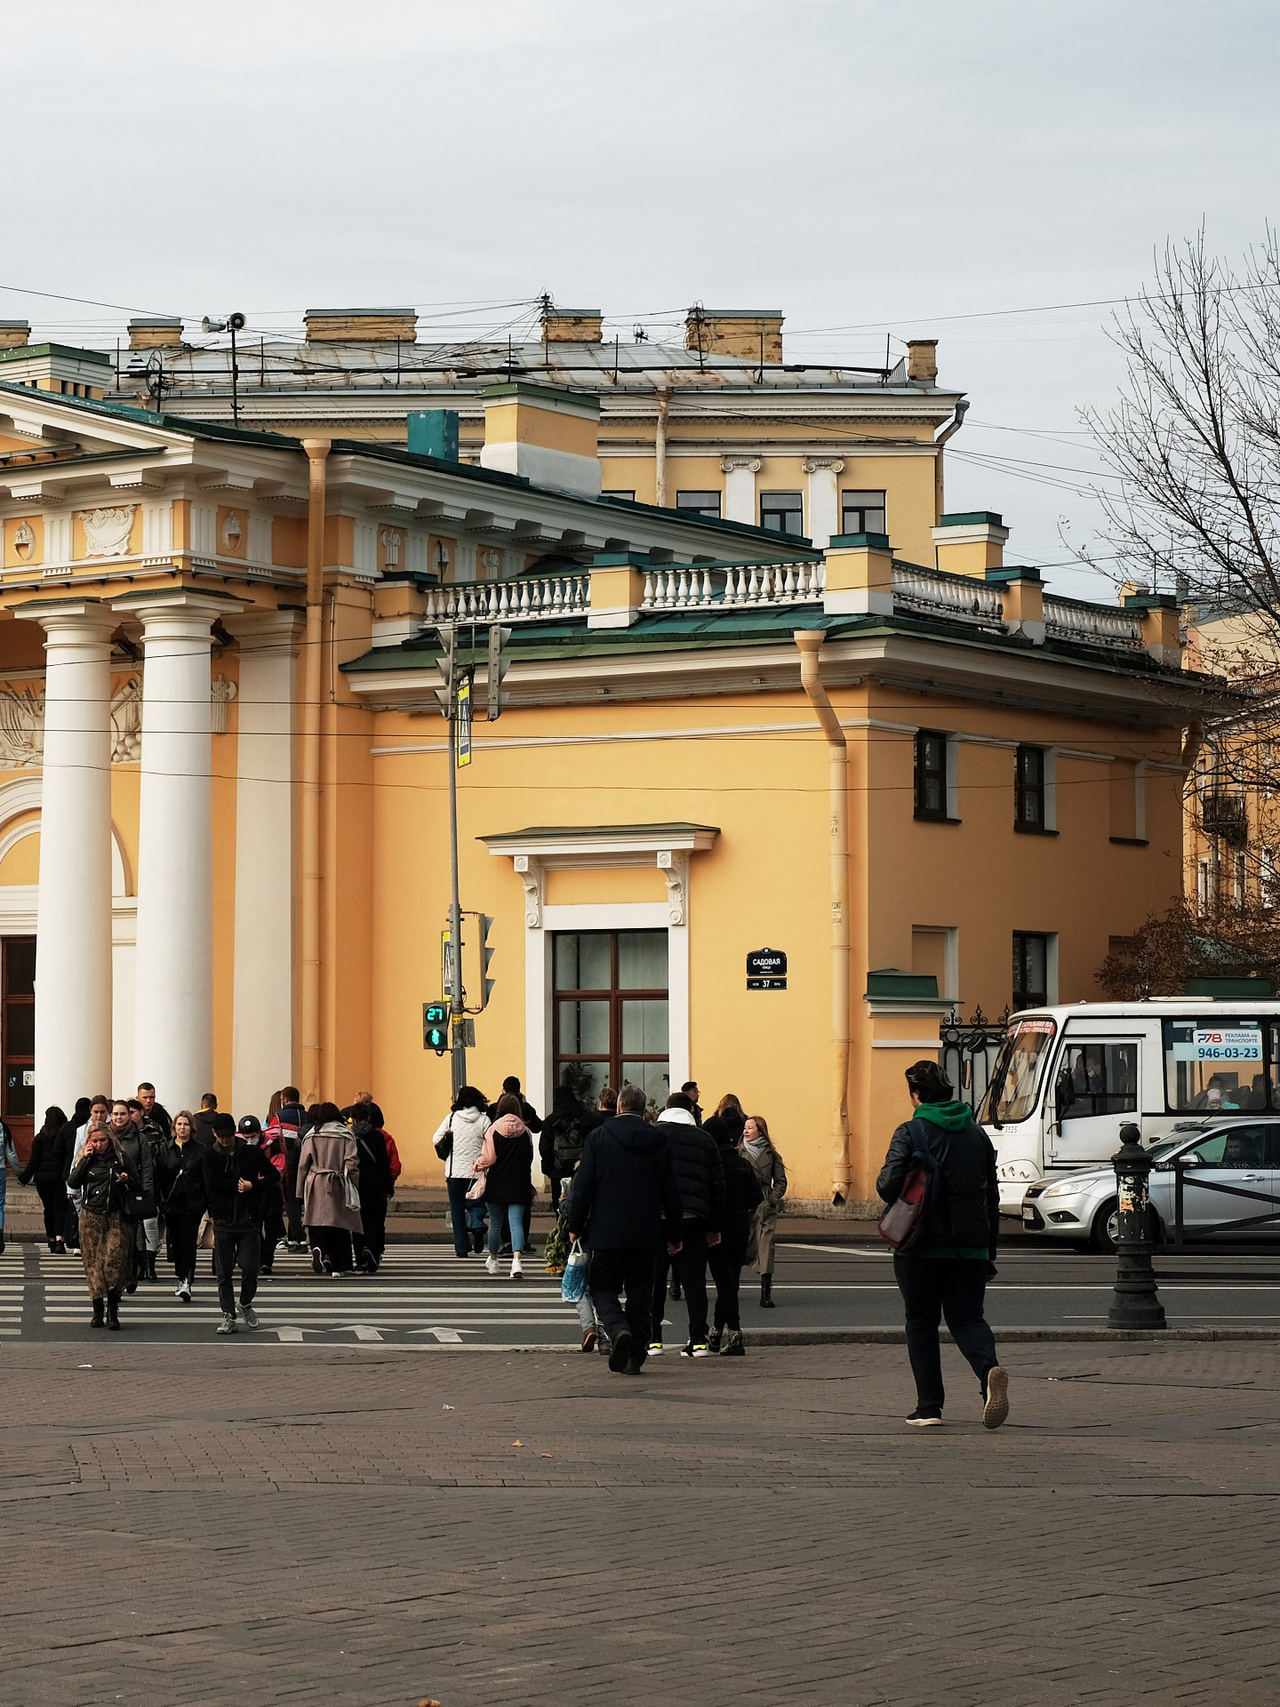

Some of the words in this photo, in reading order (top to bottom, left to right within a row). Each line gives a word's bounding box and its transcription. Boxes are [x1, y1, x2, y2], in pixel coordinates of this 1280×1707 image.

[752, 958, 781, 967] САДОВАЯ
[762, 980, 771, 988] 37
[427, 1008, 443, 1021] 27
[1198, 1047, 1259, 1059] 946-03-23
